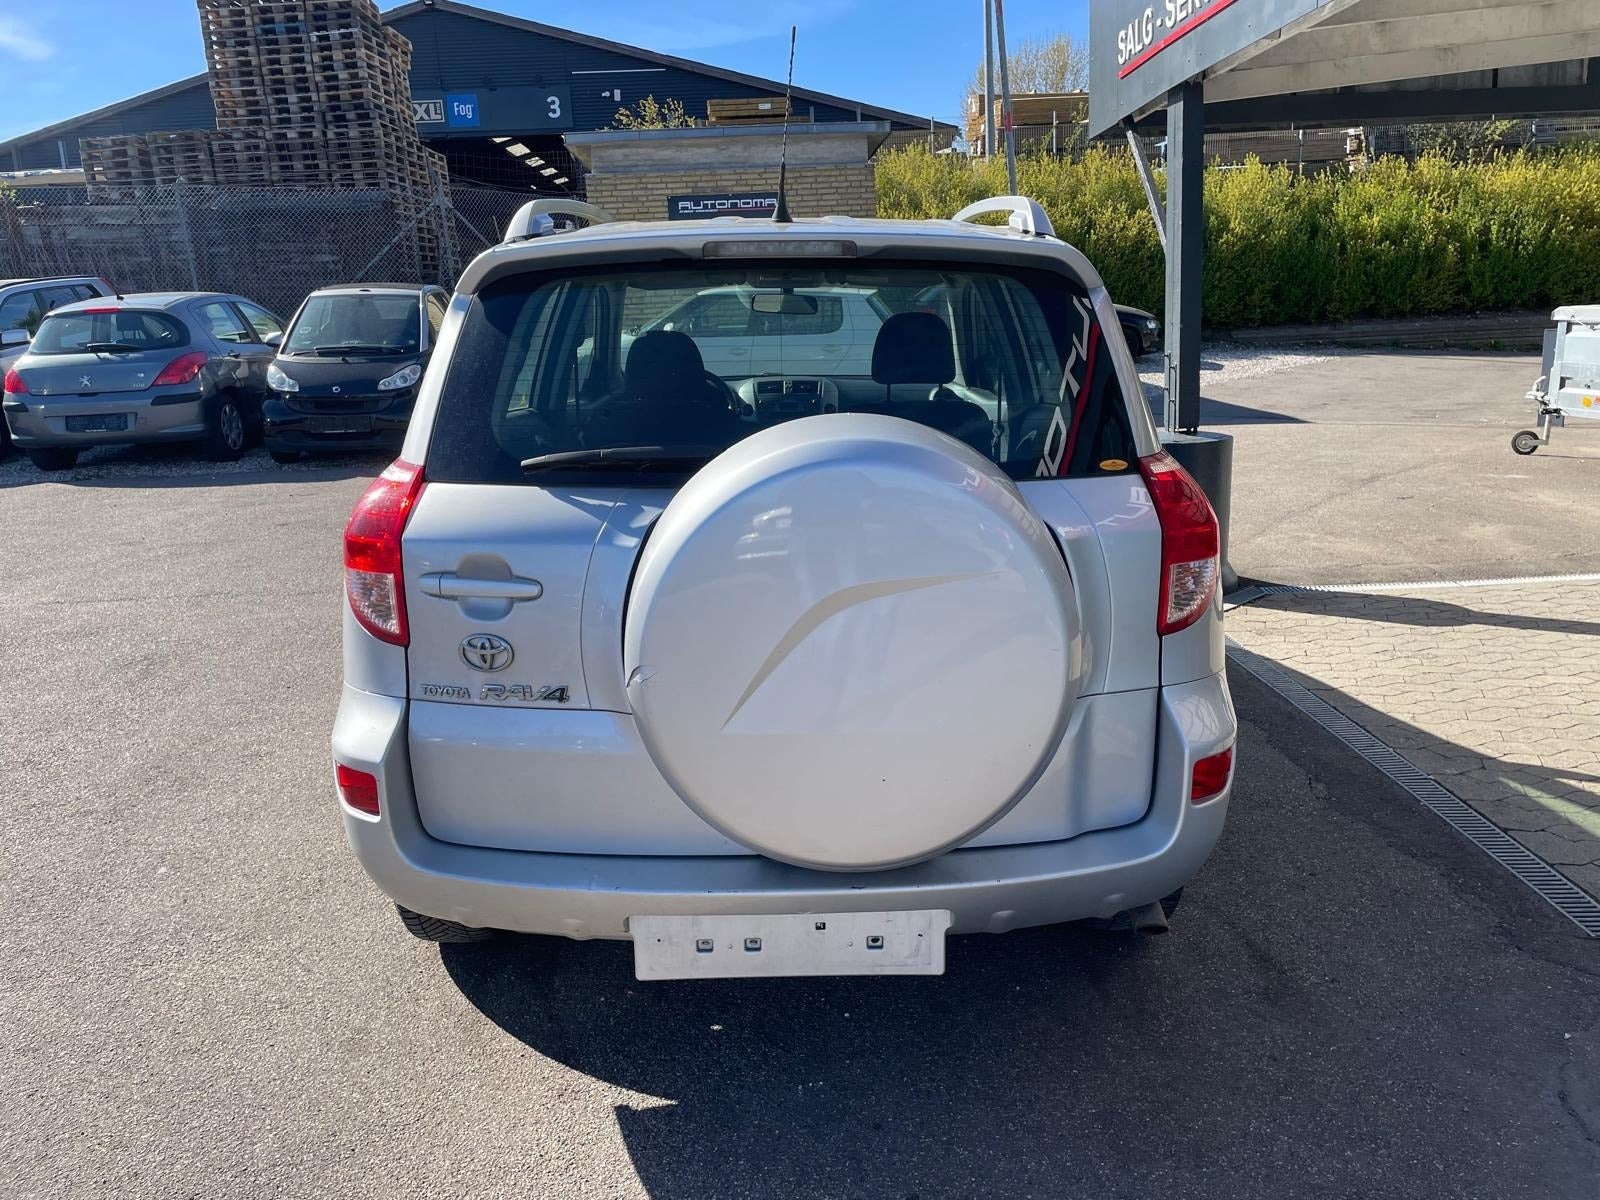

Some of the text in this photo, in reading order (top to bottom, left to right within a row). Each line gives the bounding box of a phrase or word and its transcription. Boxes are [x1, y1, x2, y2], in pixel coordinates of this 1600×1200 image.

[1117, 7, 1153, 65] SALG
[412, 103, 442, 121] XL
[454, 102, 473, 119] Fog
[547, 96, 561, 118] 3
[421, 684, 570, 703] TOYOTA RAV4
